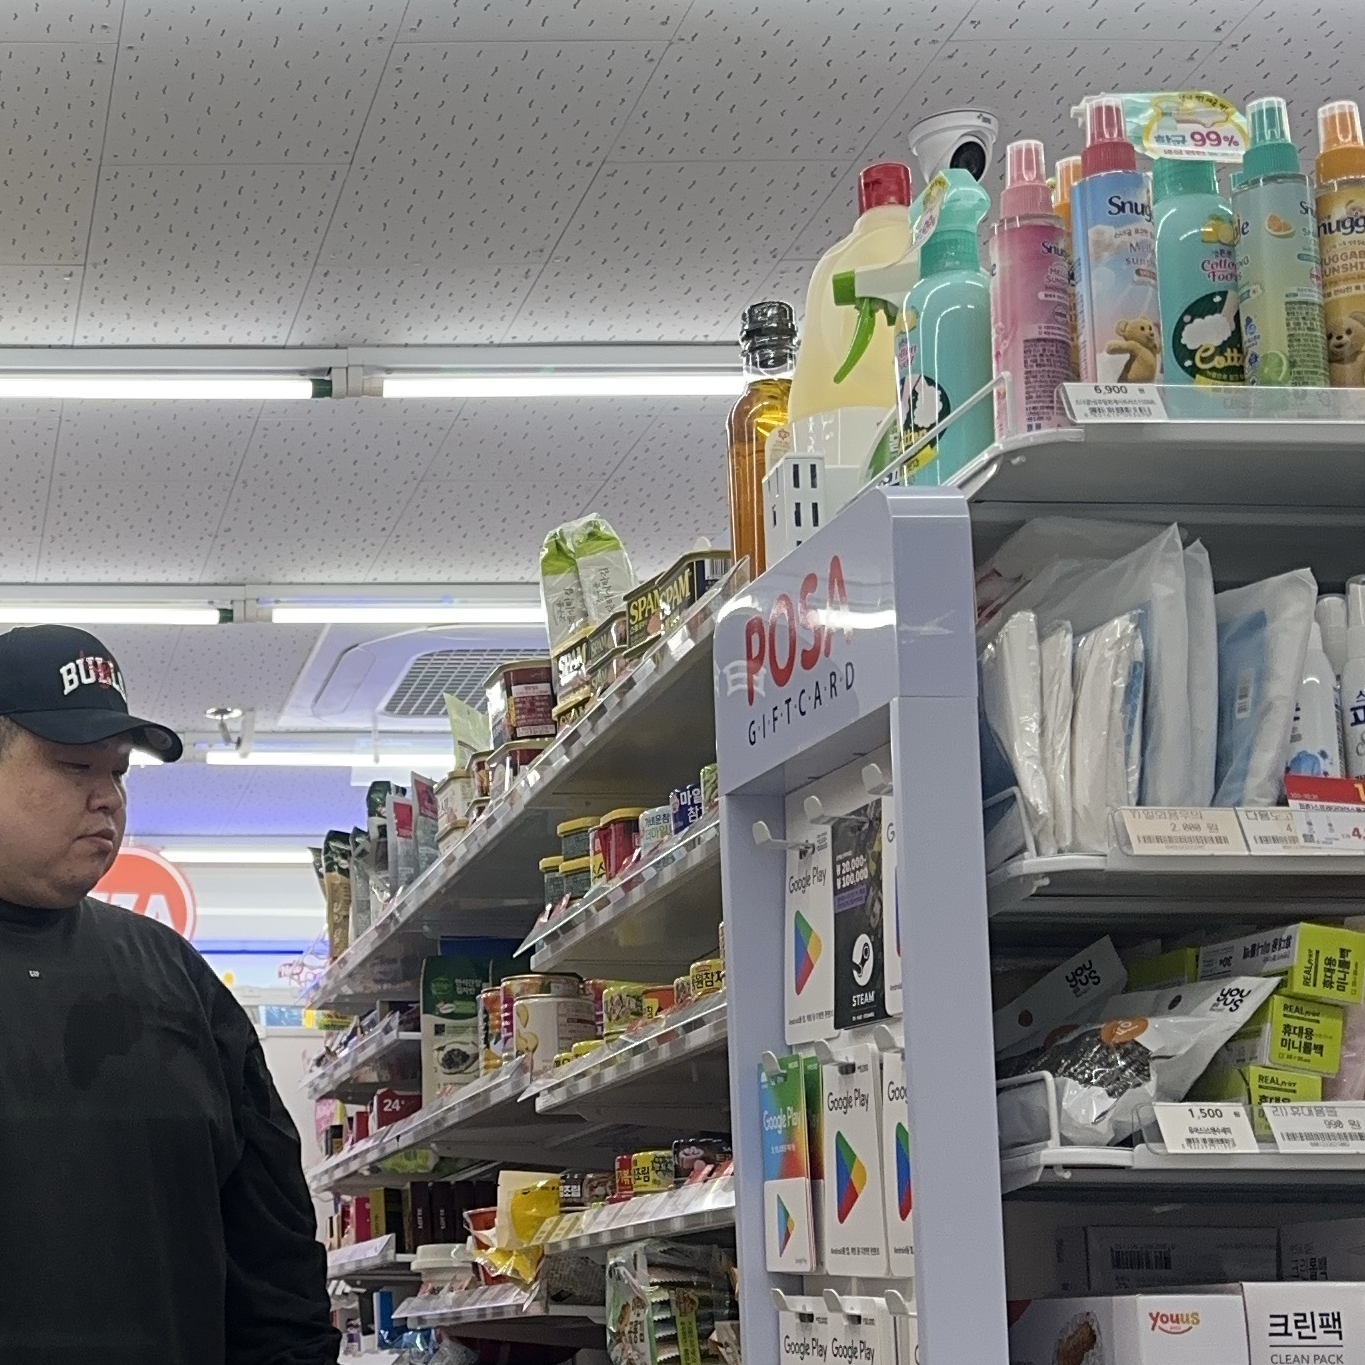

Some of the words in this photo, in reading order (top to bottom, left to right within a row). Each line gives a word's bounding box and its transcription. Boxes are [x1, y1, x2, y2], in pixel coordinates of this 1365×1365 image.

[1190, 130, 1240, 147] 99%
[1094, 386, 1128, 395] 6,900
[745, 555, 853, 707] POSA
[789, 869, 812, 894] Google
[812, 865, 828, 886] Play
[1322, 956, 1337, 990] 휴대용
[852, 990, 876, 1008] STEAM
[1282, 1023, 1316, 1041] 휴대용
[827, 1091, 854, 1115] Google
[854, 1088, 869, 1112] Play
[1188, 1108, 1223, 1120] 1,500
[763, 1109, 787, 1135] Google
[1149, 1311, 1201, 1332] youus
[1268, 1311, 1344, 1341] 크린팩
[784, 1335, 810, 1361] Google
[811, 1337, 828, 1362] Play
[831, 1337, 858, 1365] Google
[859, 1340, 875, 1365] Play
[1270, 1354, 1310, 1365] CLEAN
[1313, 1354, 1345, 1365] PACK
